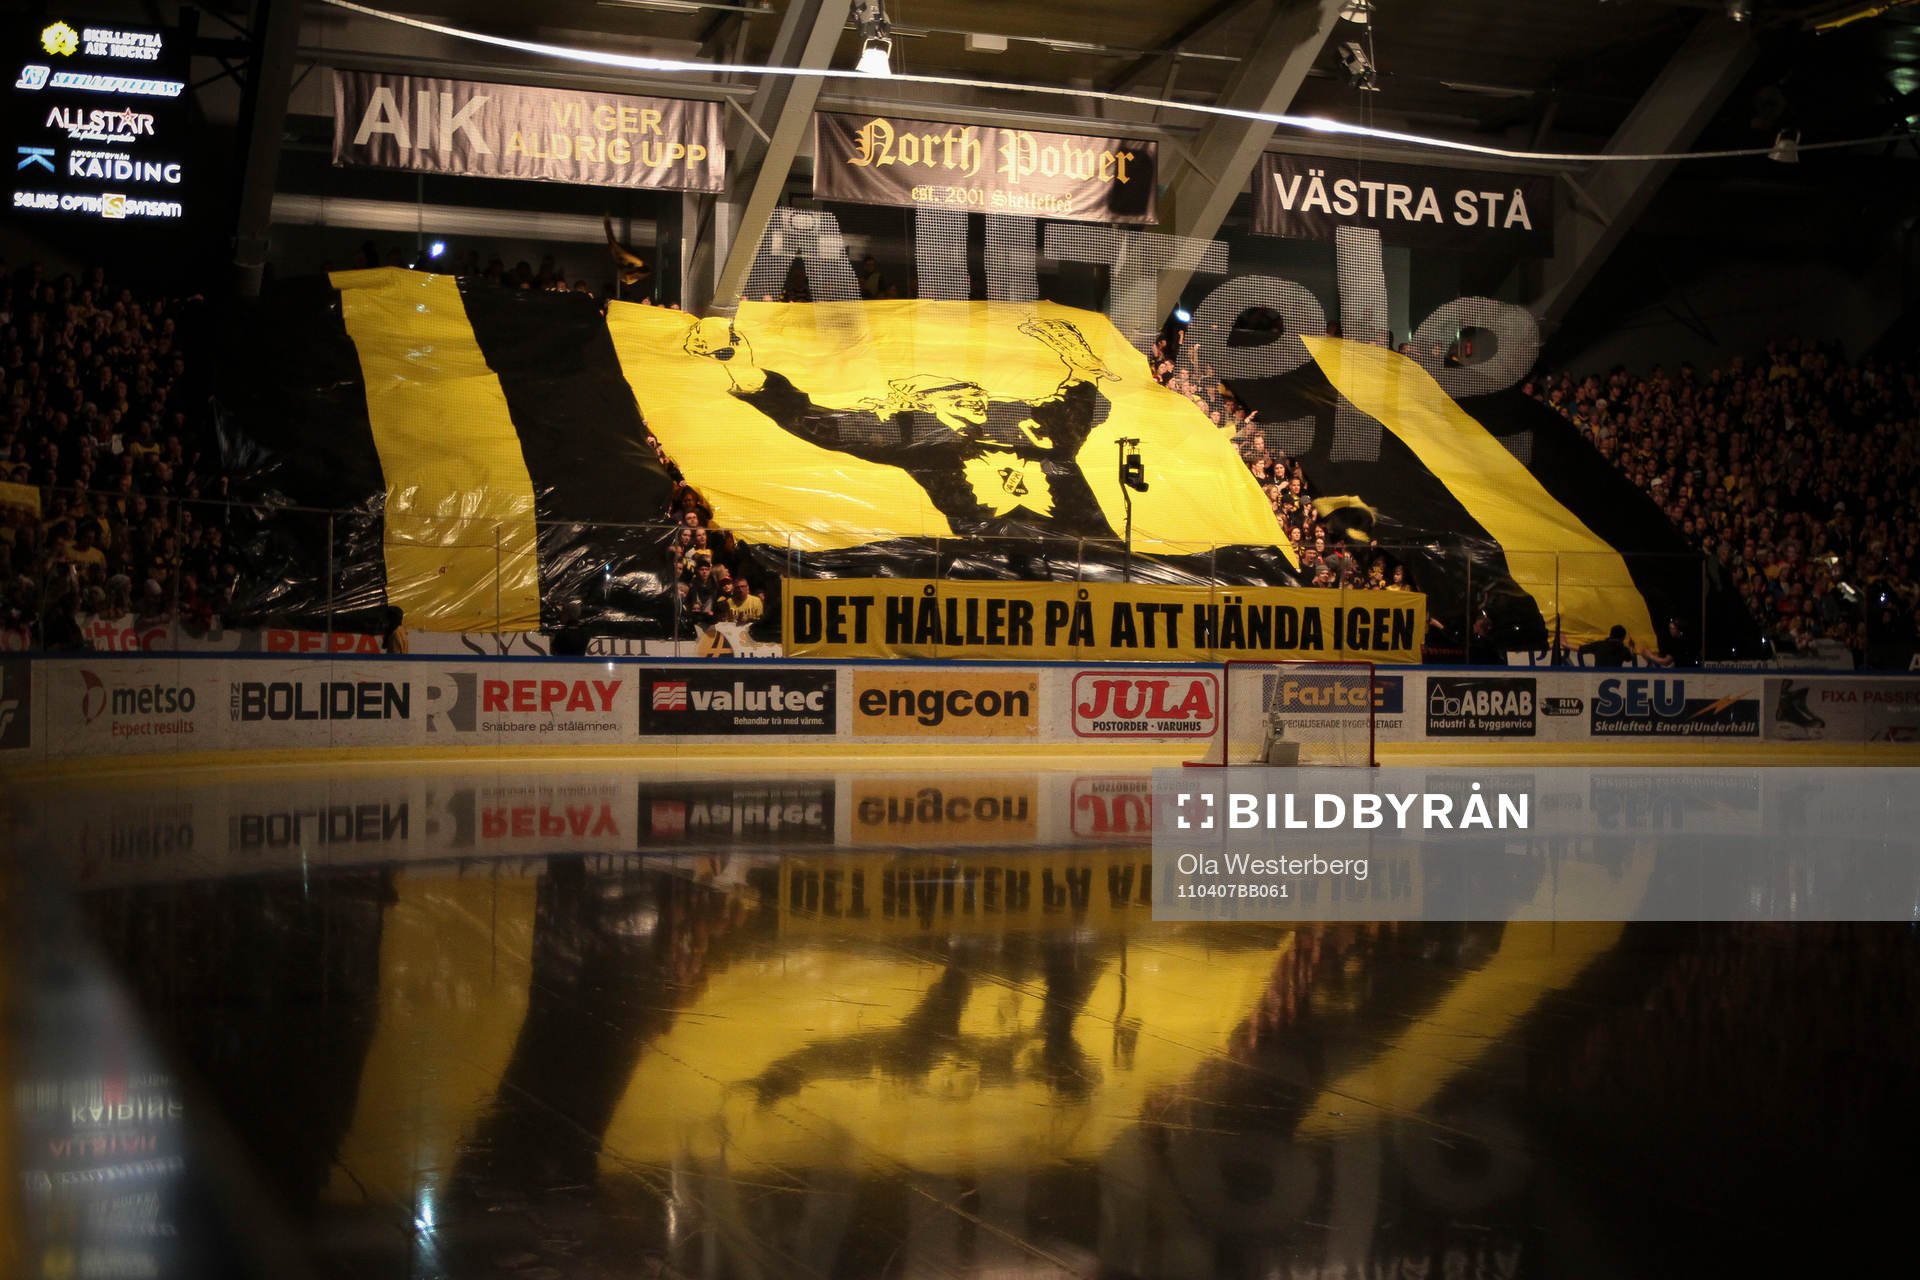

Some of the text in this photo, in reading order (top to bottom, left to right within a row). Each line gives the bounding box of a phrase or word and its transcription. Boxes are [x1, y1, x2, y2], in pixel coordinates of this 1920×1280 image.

[46, 106, 154, 135] ALLSTAR
[353, 86, 493, 155] AIK
[551, 101, 664, 136] VI GER
[505, 131, 708, 170] ALDRIG UPP
[847, 117, 1135, 184] North Power
[69, 157, 181, 184] KAIDING
[944, 187, 985, 206] 2001
[1273, 169, 1532, 231] VÄSTRA STÅ
[793, 584, 1415, 651] DET HÅLLER PÅ ATT HÄNDA IGEN
[112, 684, 196, 714] metso
[241, 682, 410, 721] BOLIDEN
[483, 680, 623, 712] REPAY
[691, 682, 824, 711] valutec
[859, 688, 1029, 726] engcon
[1078, 681, 1213, 719] JULA
[1461, 689, 1533, 716] ABRAB
[1559, 699, 1578, 708] RIV
[1595, 679, 1686, 717] SEU
[1822, 690, 1857, 702] FIXA
[112, 720, 194, 738] Expect results
[482, 721, 536, 733] Snabbare
[540, 721, 554, 734] på
[783, 717, 799, 725] med
[1092, 722, 1201, 731] POSTORDER VARUHUS
[1430, 718, 1533, 731] industri & byggservice
[1595, 719, 1653, 733] Skellefteå
